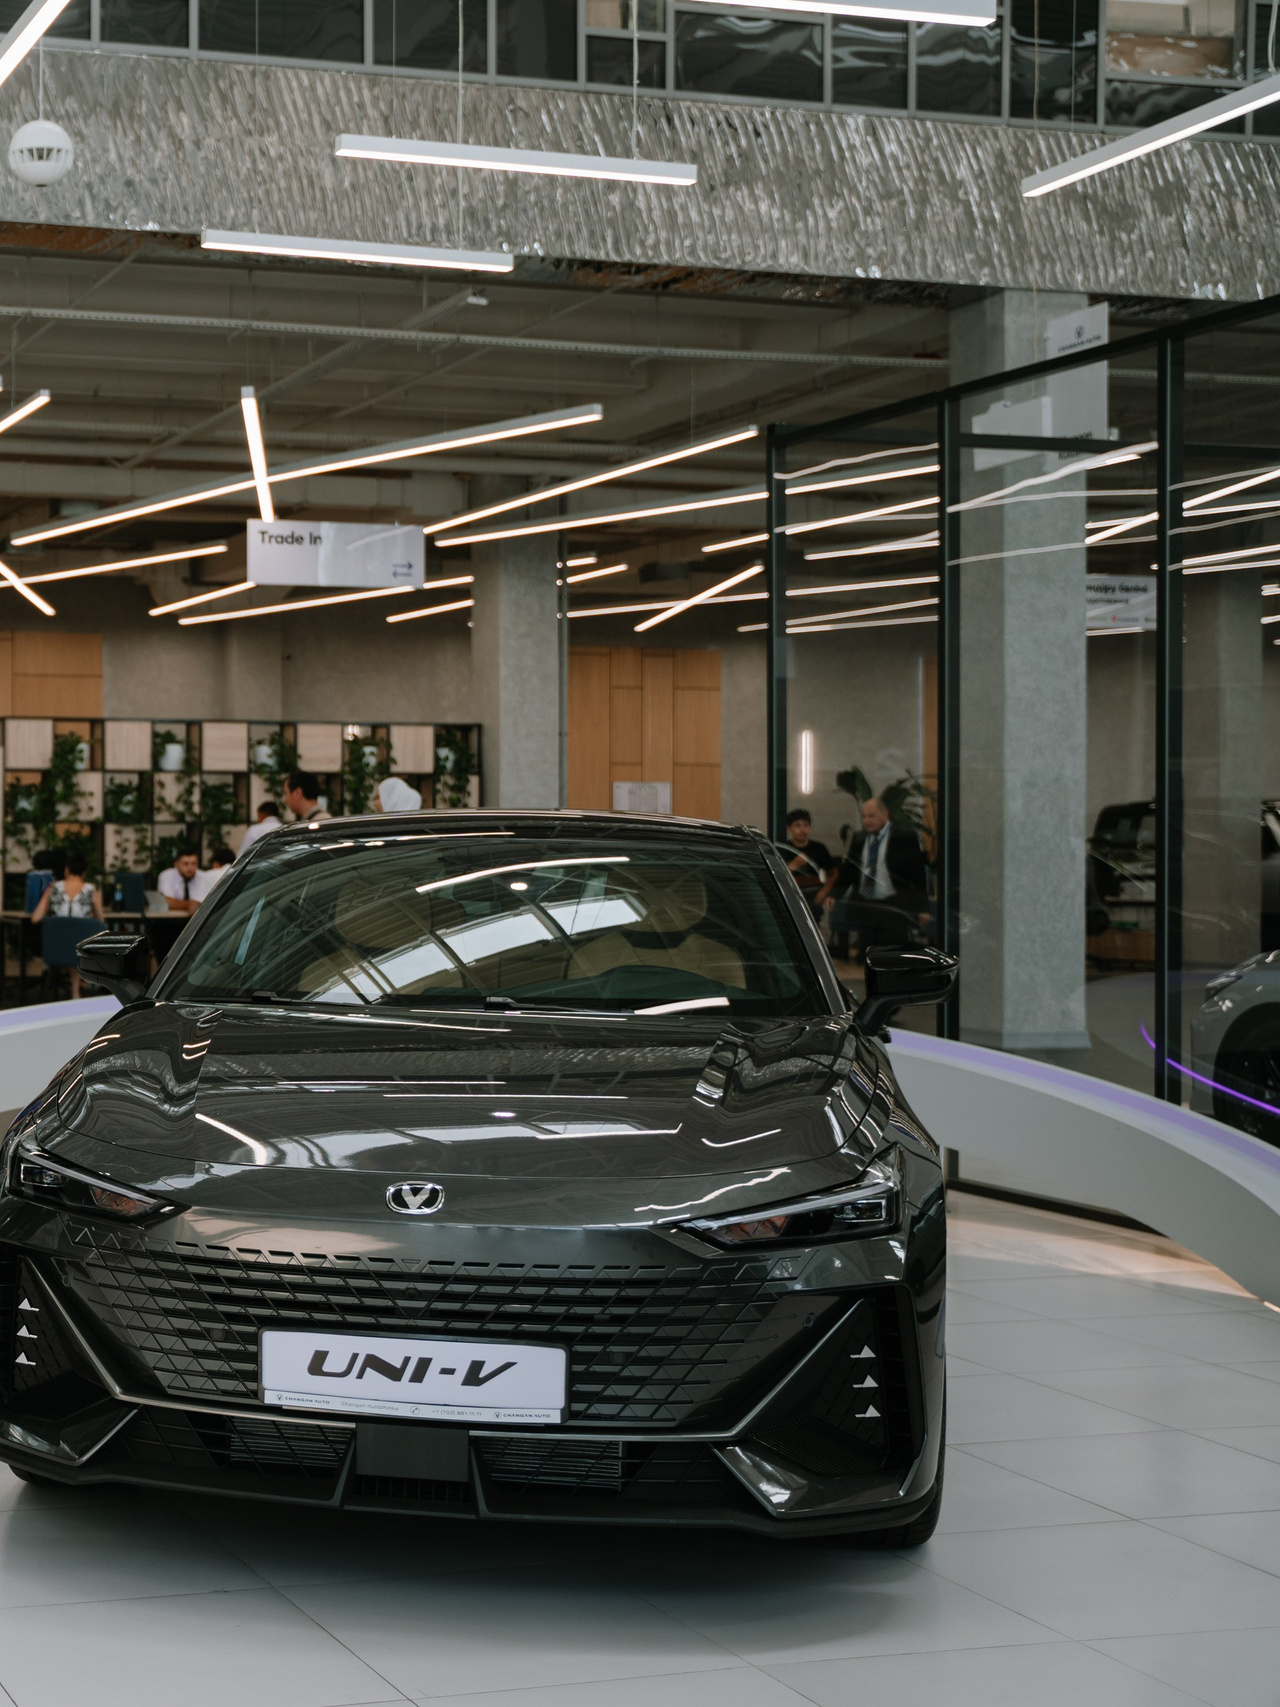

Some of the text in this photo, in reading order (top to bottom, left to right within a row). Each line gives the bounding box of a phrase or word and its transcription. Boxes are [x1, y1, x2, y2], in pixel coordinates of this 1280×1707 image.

[258, 530, 322, 546] Trade In
[307, 1350, 518, 1387] UNI-V
[341, 1401, 366, 1409] Changan
